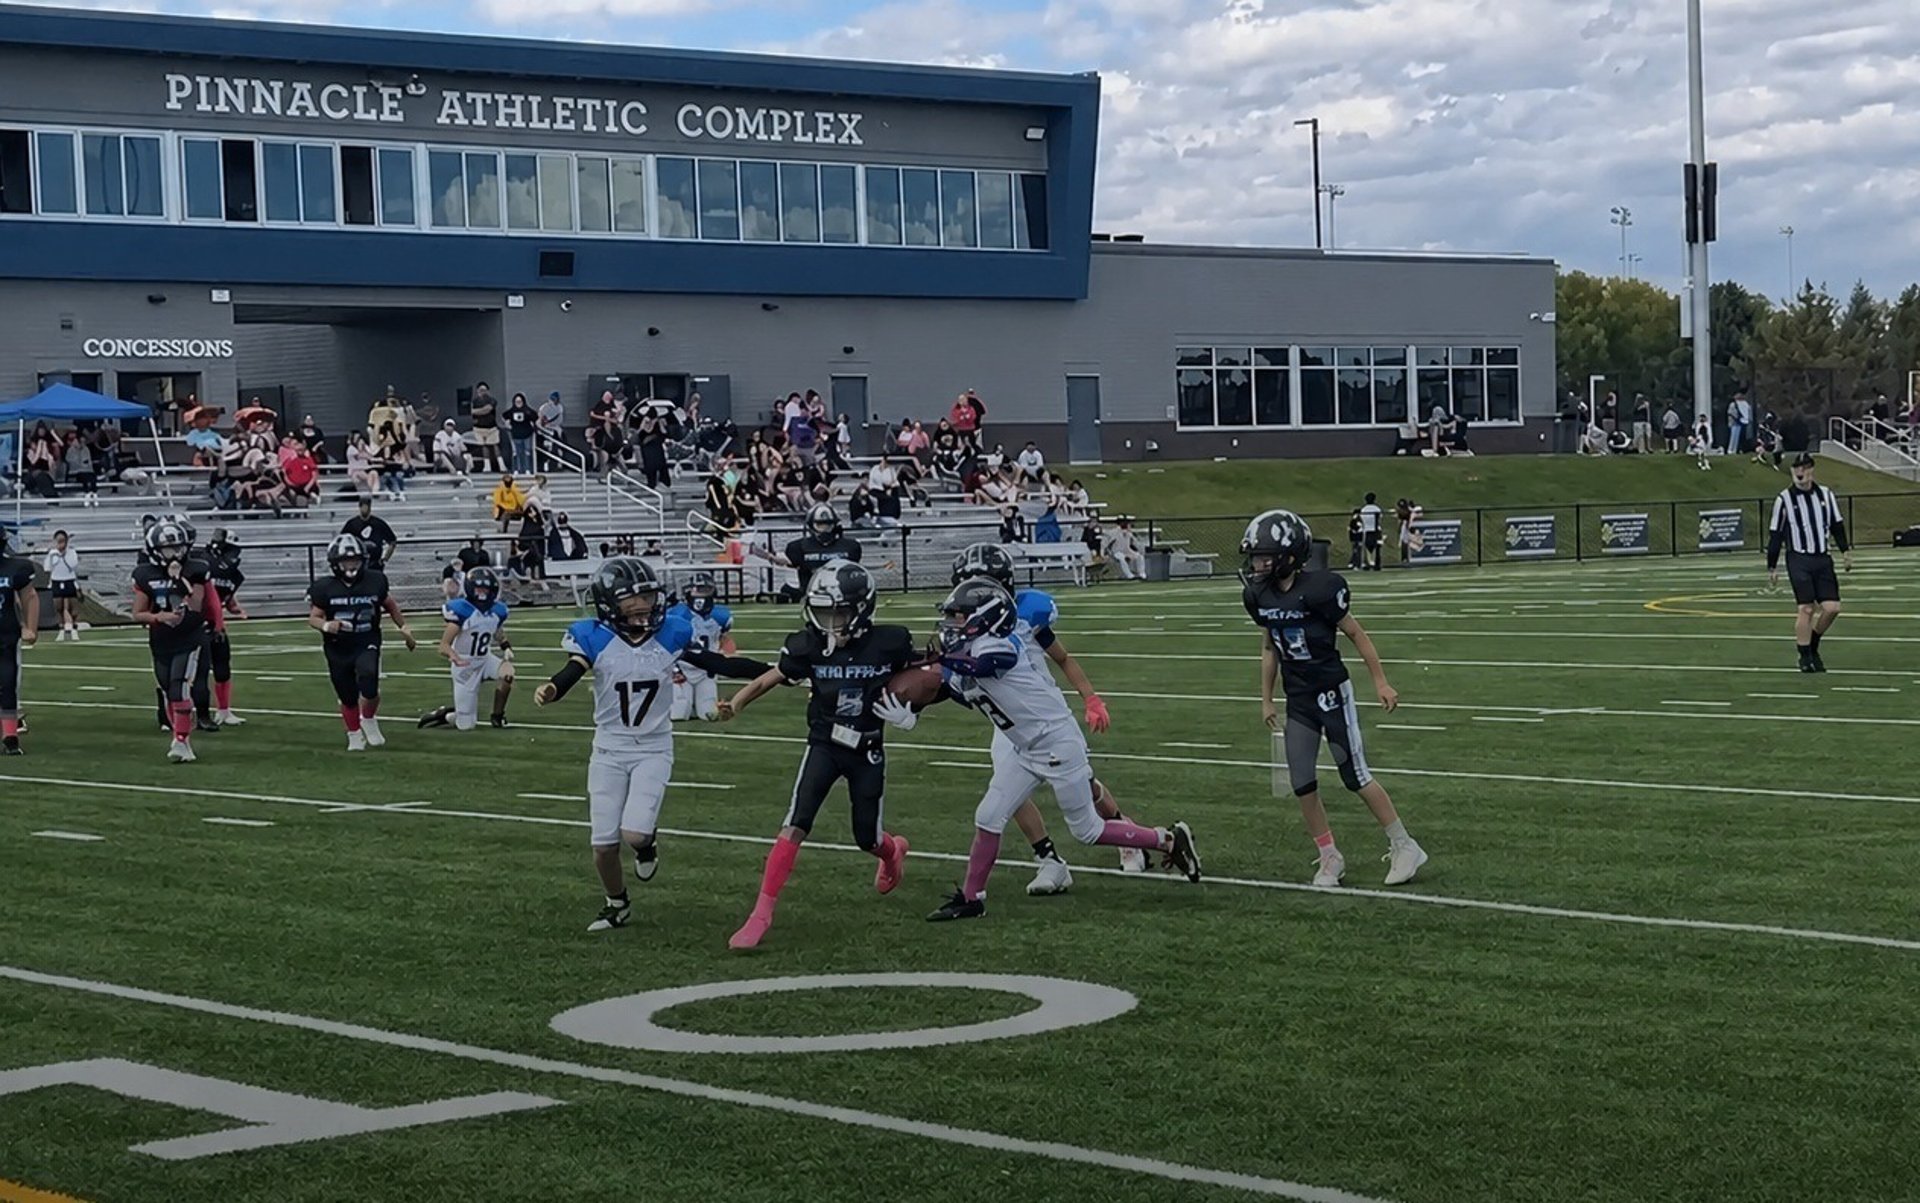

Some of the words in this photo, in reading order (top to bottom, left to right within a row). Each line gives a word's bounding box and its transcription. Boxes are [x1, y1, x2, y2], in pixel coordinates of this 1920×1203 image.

[164, 73, 405, 123] PINNACLE
[436, 90, 648, 136] ATHLETIC
[676, 104, 864, 146] COMPLEX
[82, 338, 234, 359] CONCESSIONS
[470, 632, 492, 656] 18
[614, 681, 660, 727] 17
